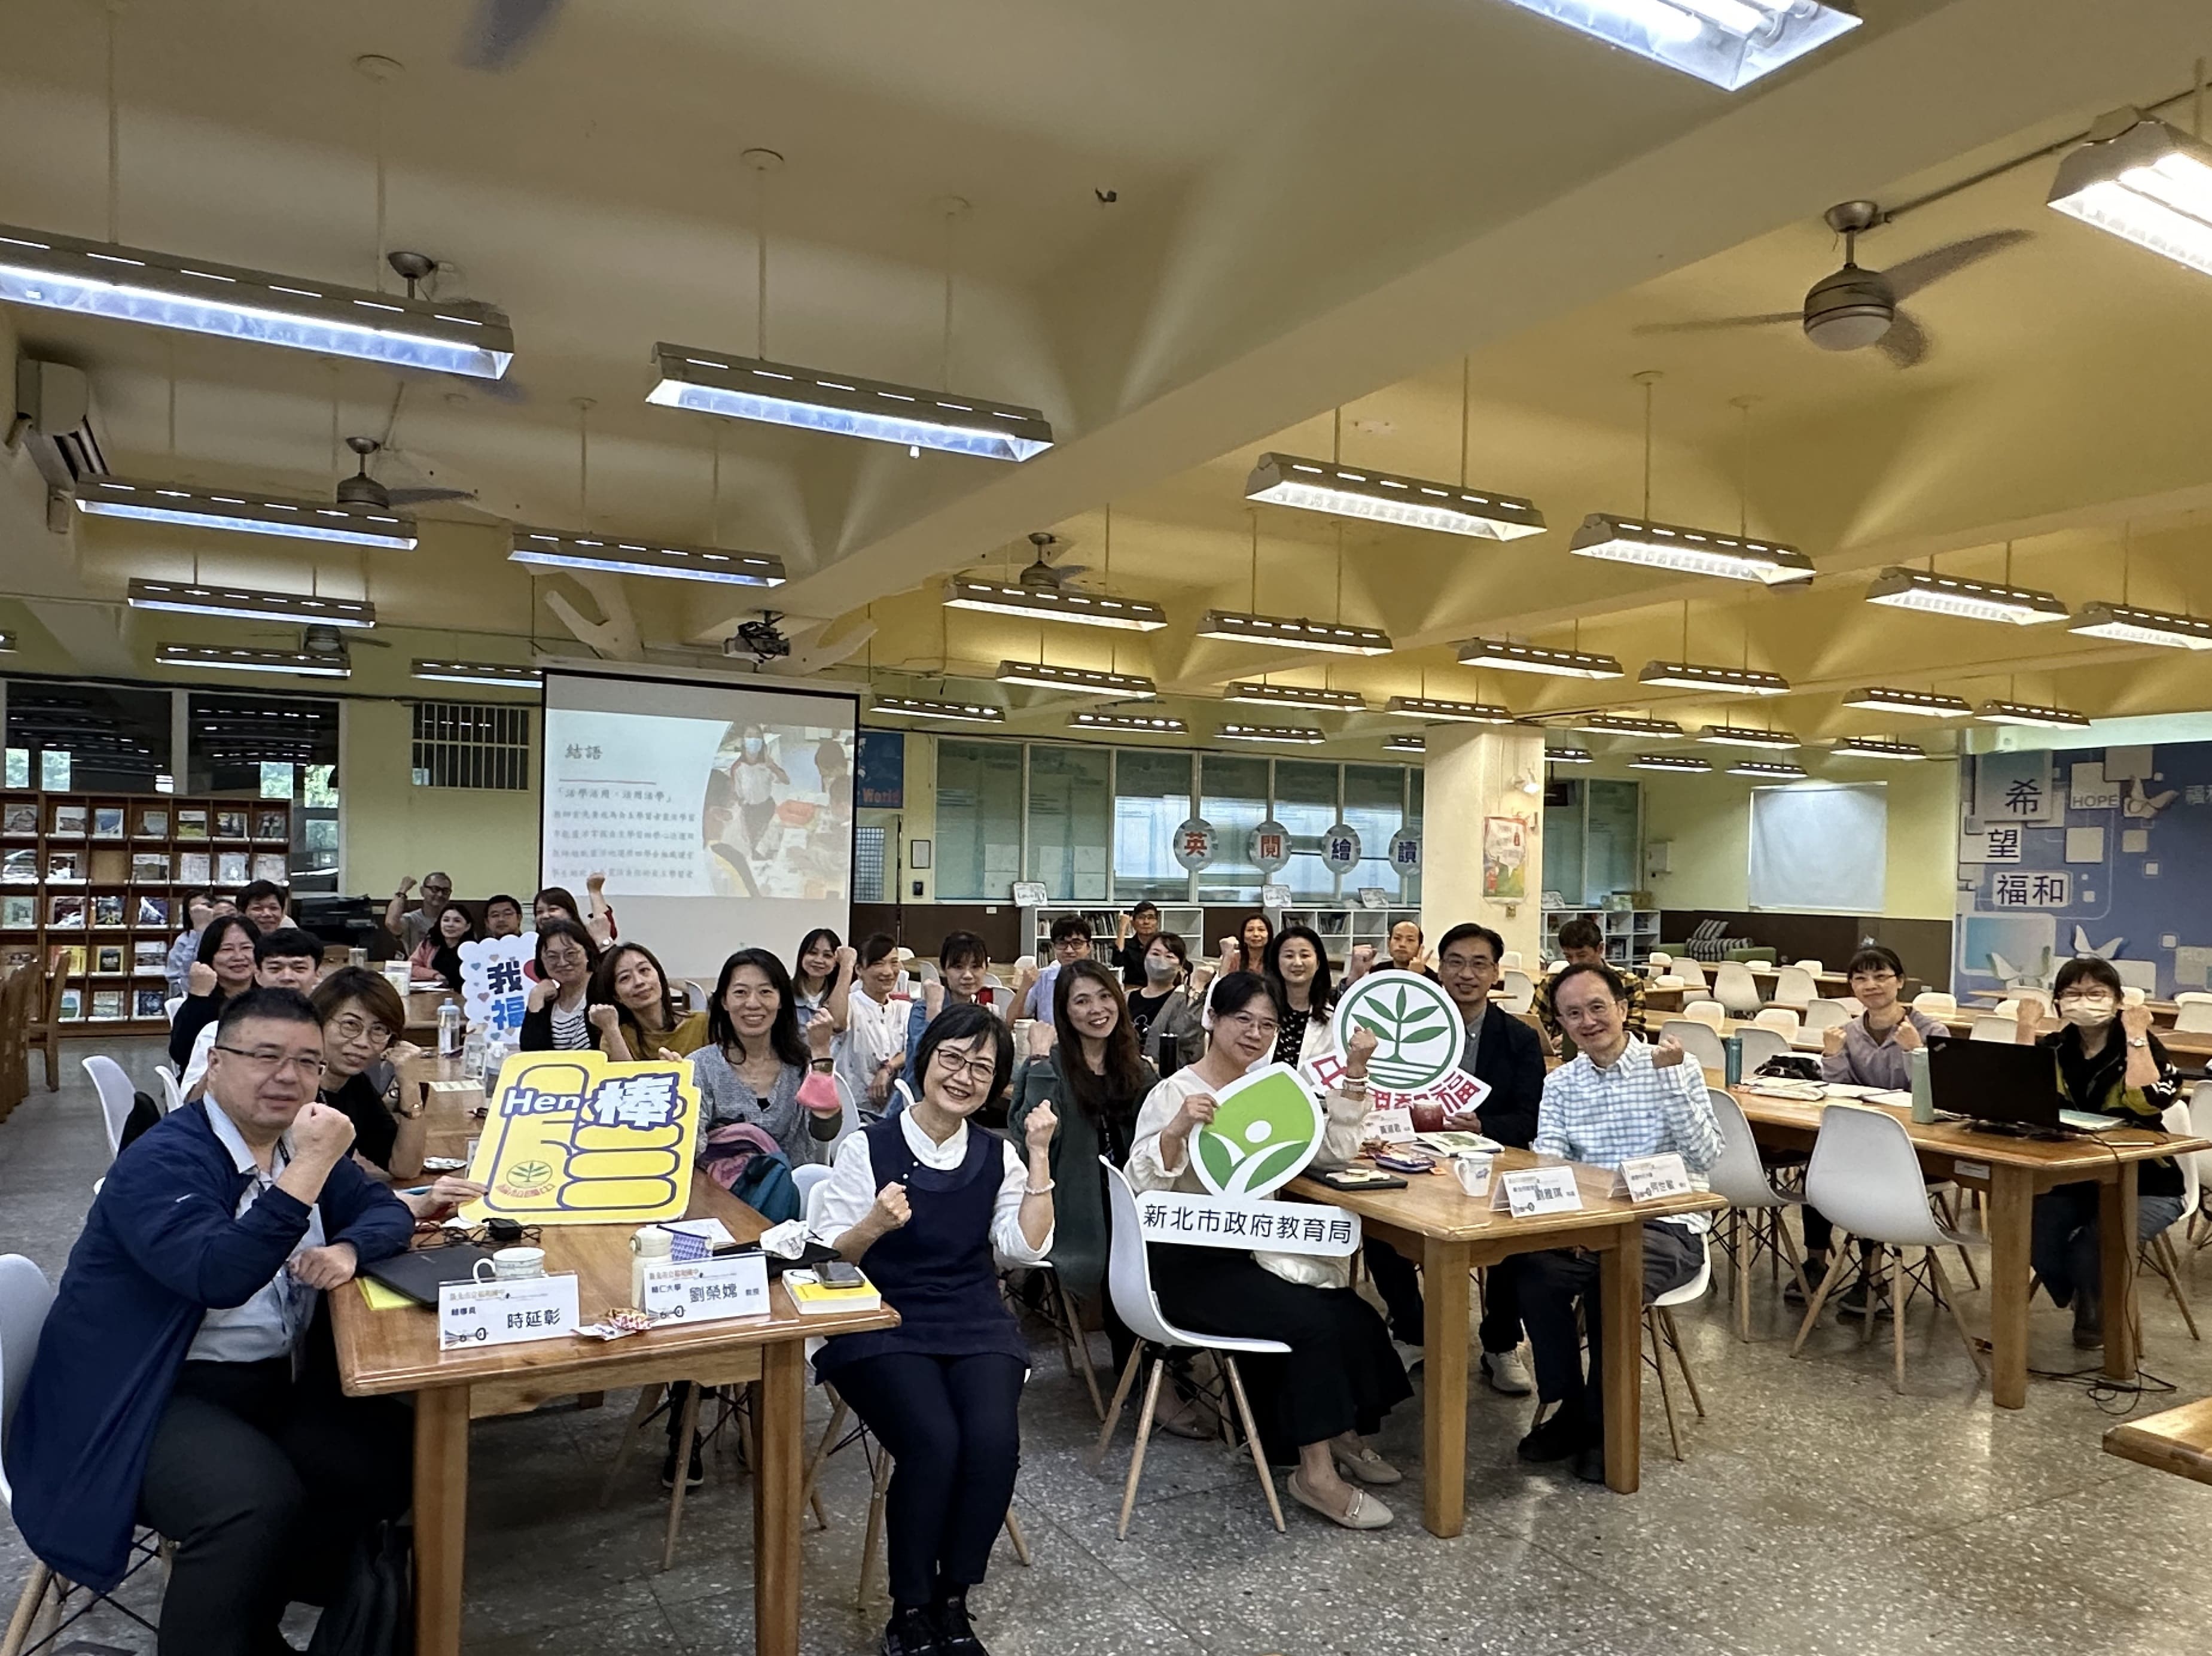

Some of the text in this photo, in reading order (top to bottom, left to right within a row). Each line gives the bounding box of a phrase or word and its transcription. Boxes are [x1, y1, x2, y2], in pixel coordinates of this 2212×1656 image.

[565, 744, 603, 760] 結語
[2006, 780, 2042, 814] 希
[2073, 796, 2118, 807] HOPE
[1184, 832, 1418, 863] 英 閱 繪 讀
[1987, 829, 2019, 858] 望
[1997, 875, 2064, 905] 福和
[487, 961, 523, 994] 我
[503, 1076, 674, 1128] Hen 棒
[1143, 1204, 1352, 1244] 新北市政府教育局
[507, 1308, 560, 1329] 時延彰
